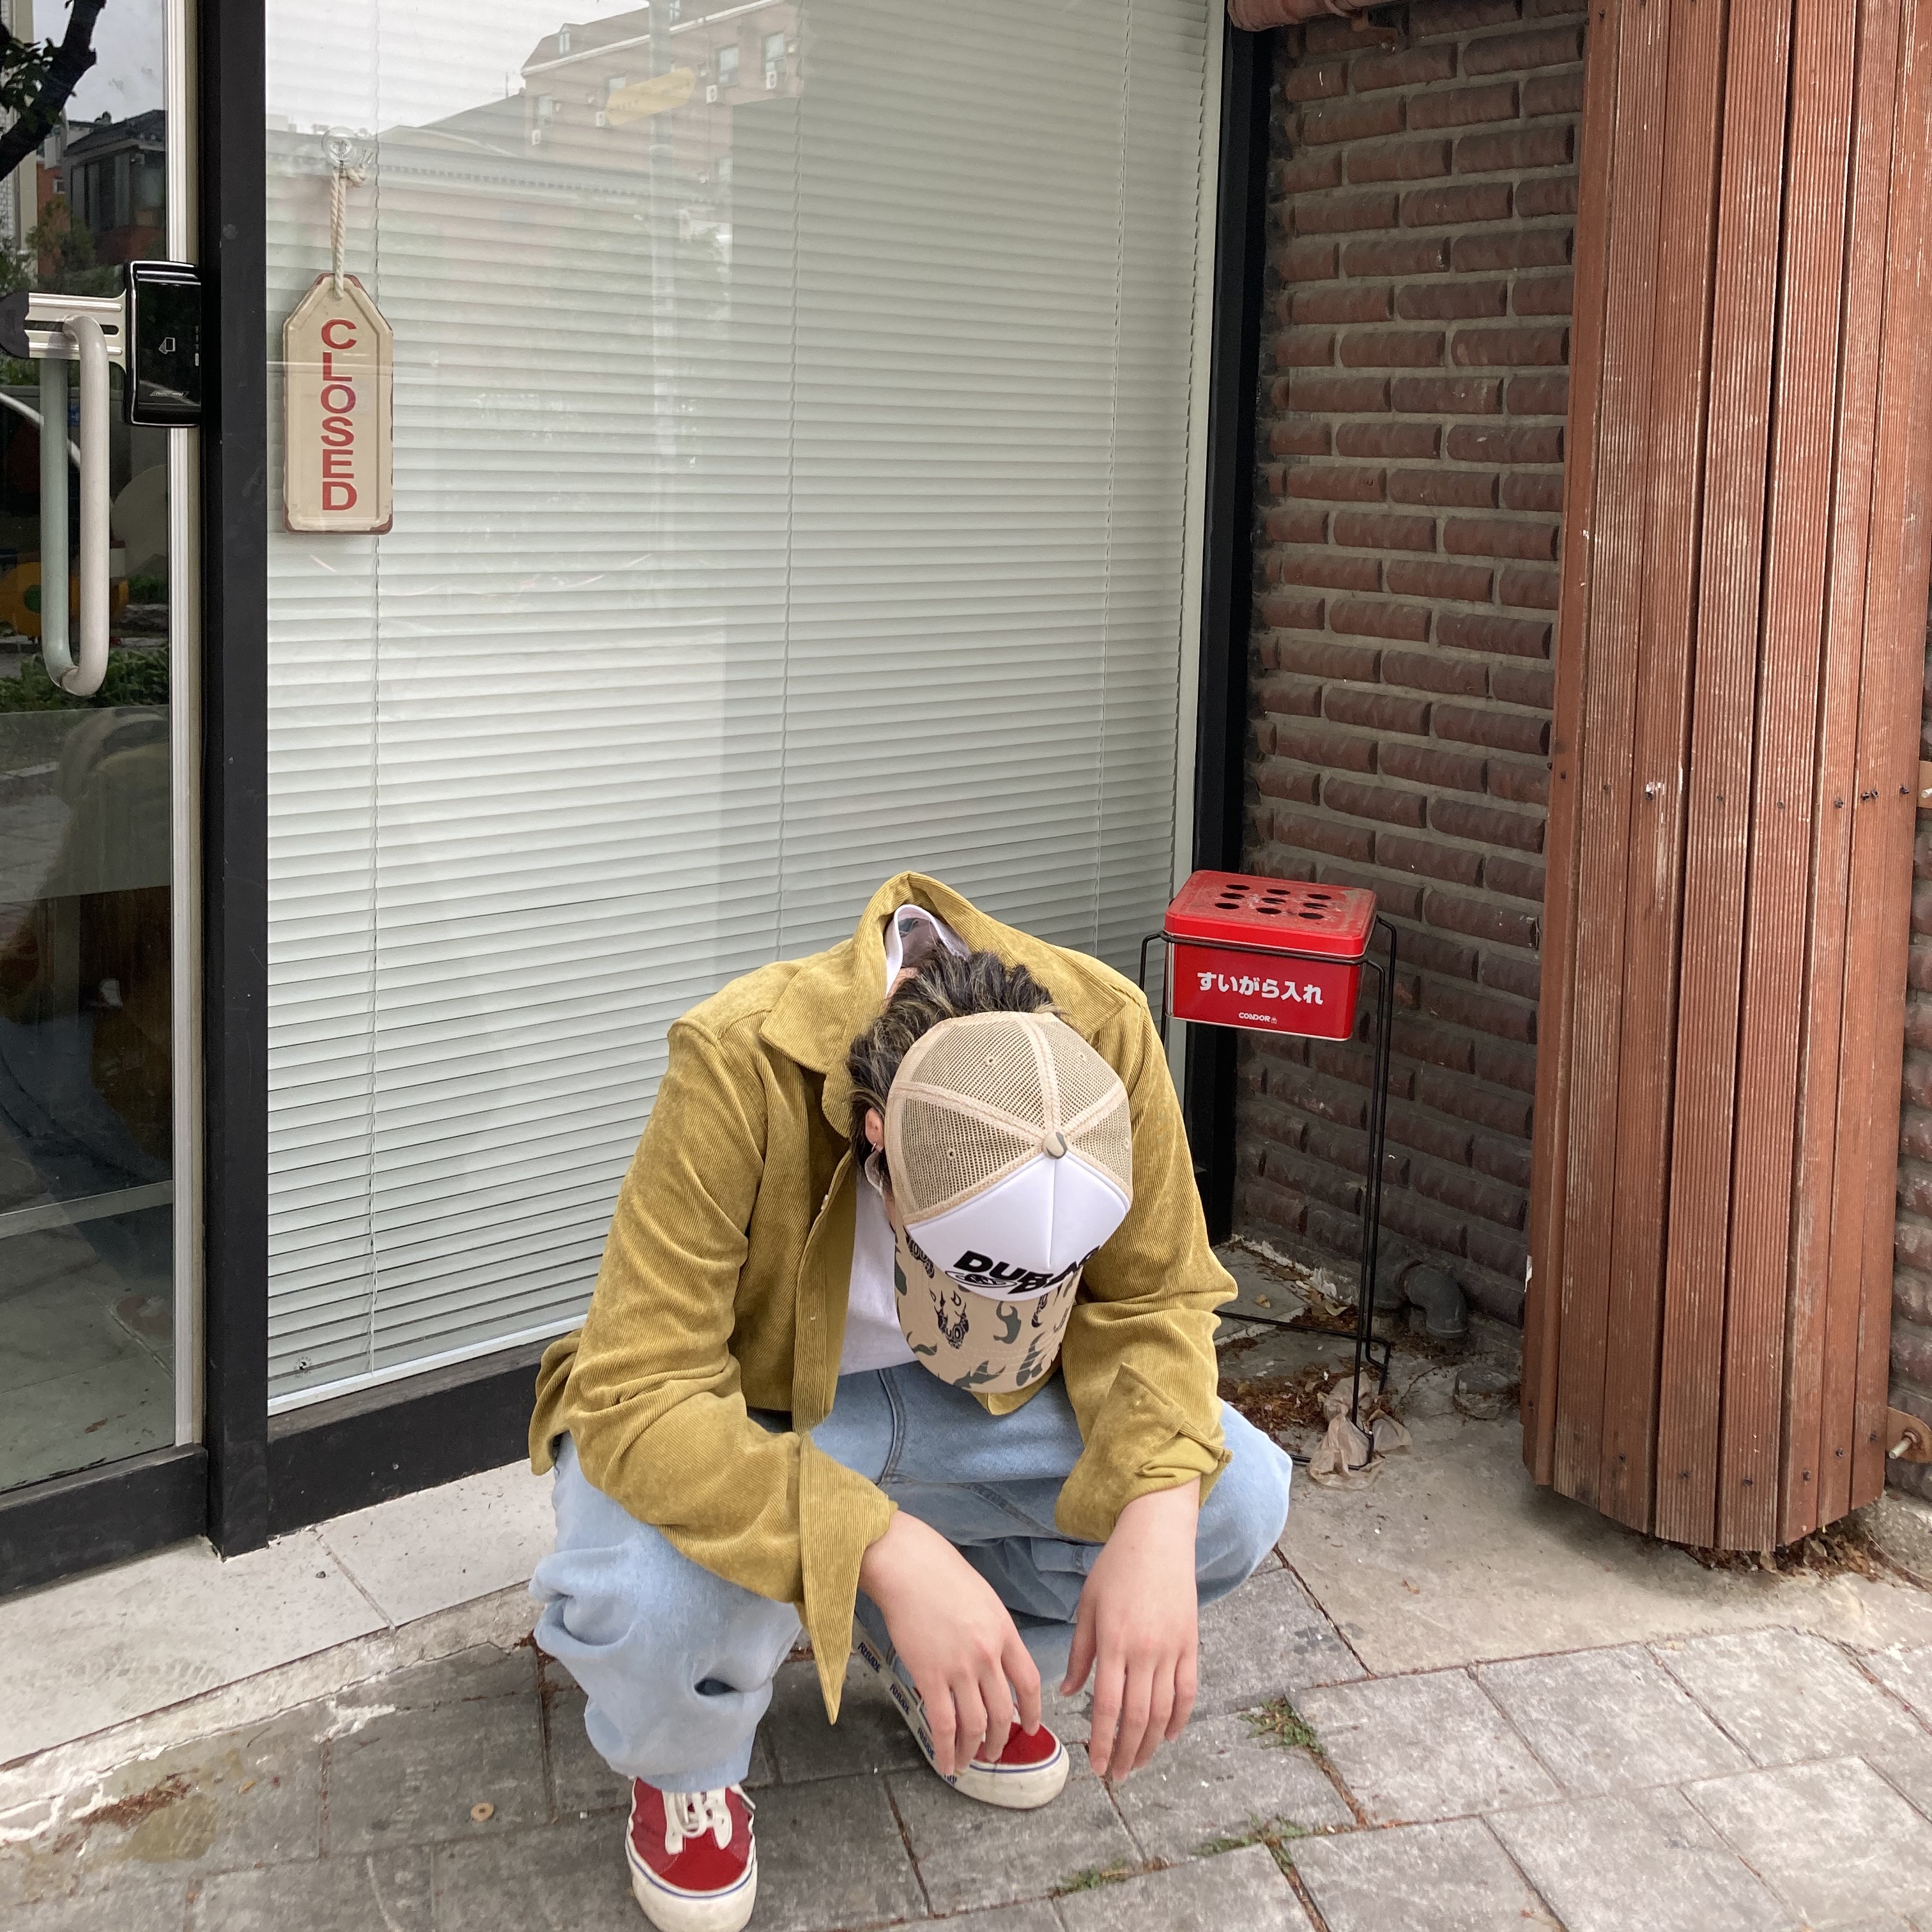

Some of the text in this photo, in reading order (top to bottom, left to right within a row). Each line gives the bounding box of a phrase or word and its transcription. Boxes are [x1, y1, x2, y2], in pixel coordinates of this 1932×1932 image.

[321, 319, 357, 511] CLOSED
[1197, 971, 1324, 1005] すいがら入れ
[1238, 1012, 1271, 1022] CONDOR
